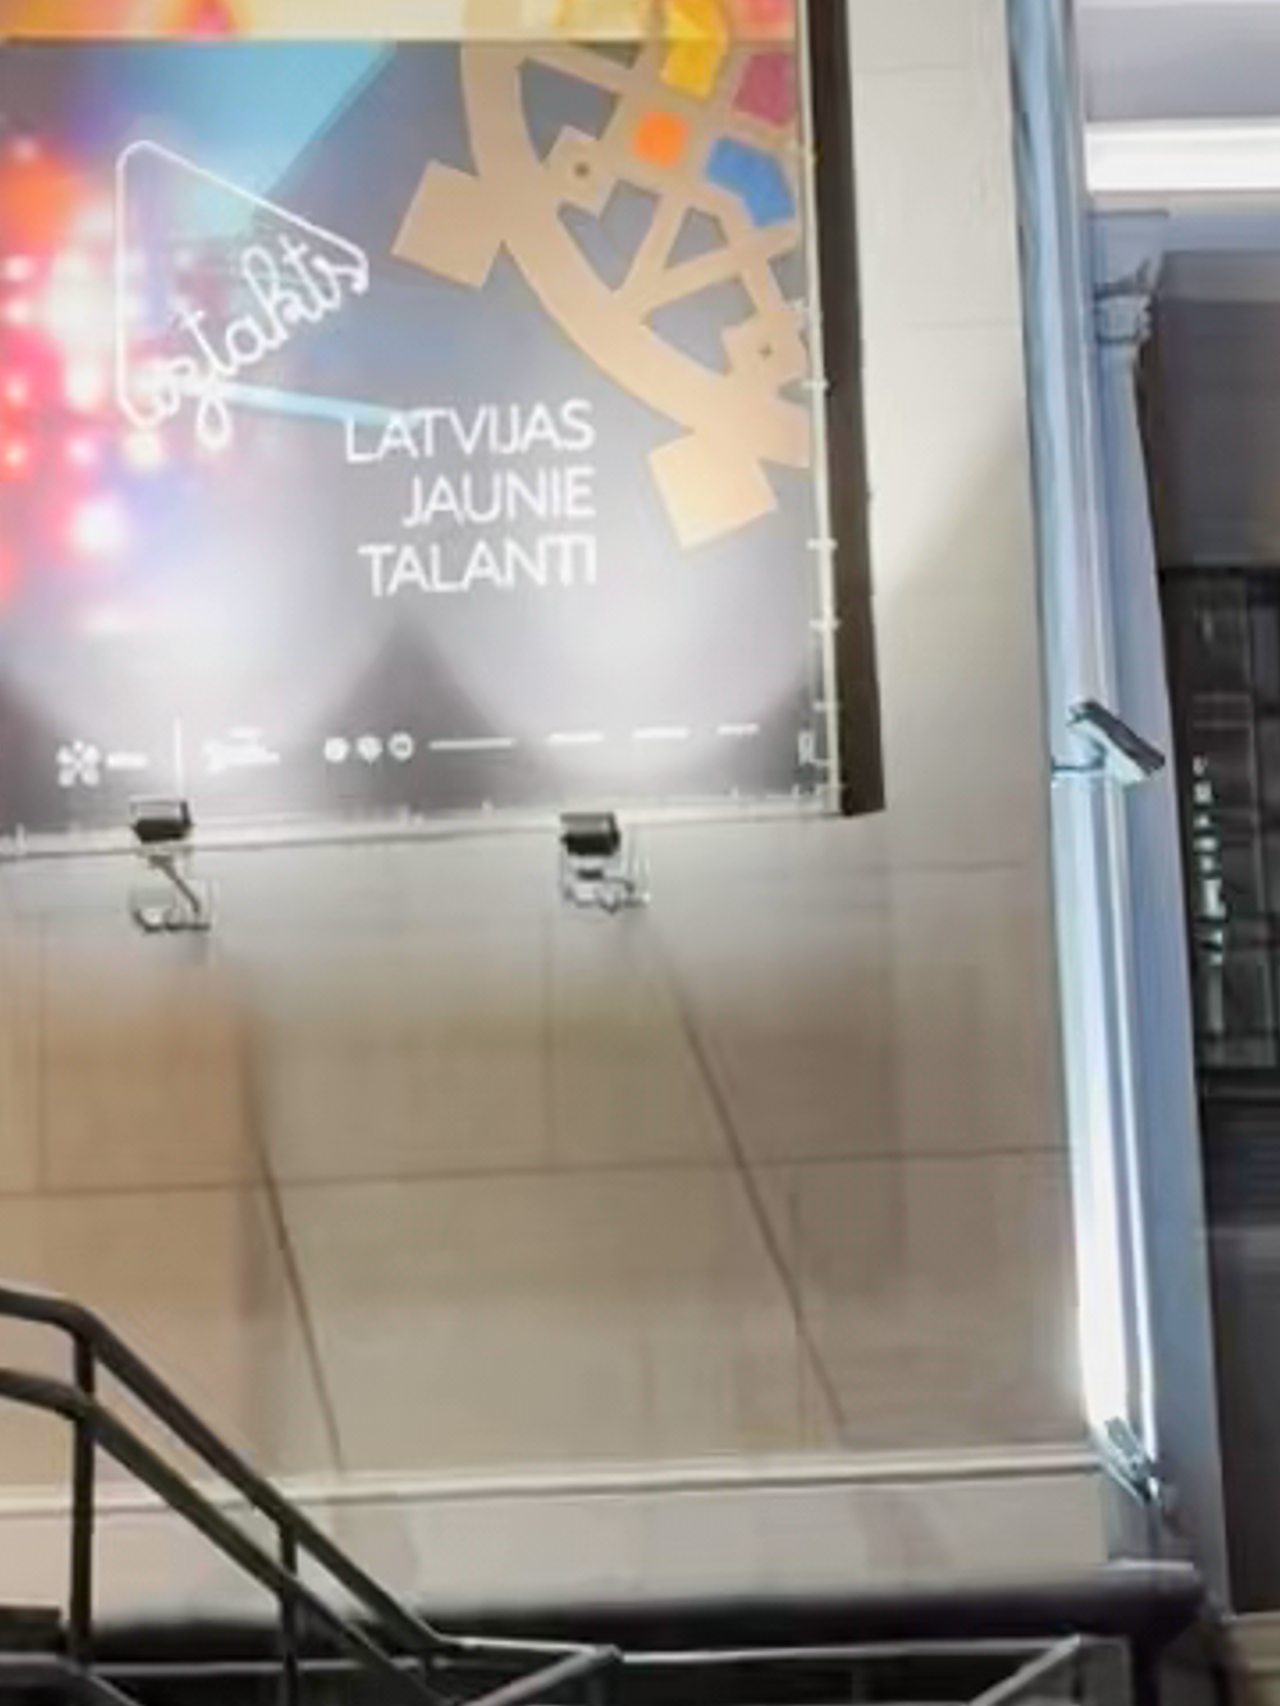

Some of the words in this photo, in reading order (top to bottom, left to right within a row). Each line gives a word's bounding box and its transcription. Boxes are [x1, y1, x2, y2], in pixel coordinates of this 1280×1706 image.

[344, 399, 594, 464] LATVIJAS
[403, 468, 595, 527] JAUNIE
[358, 534, 597, 597] TALANTI
